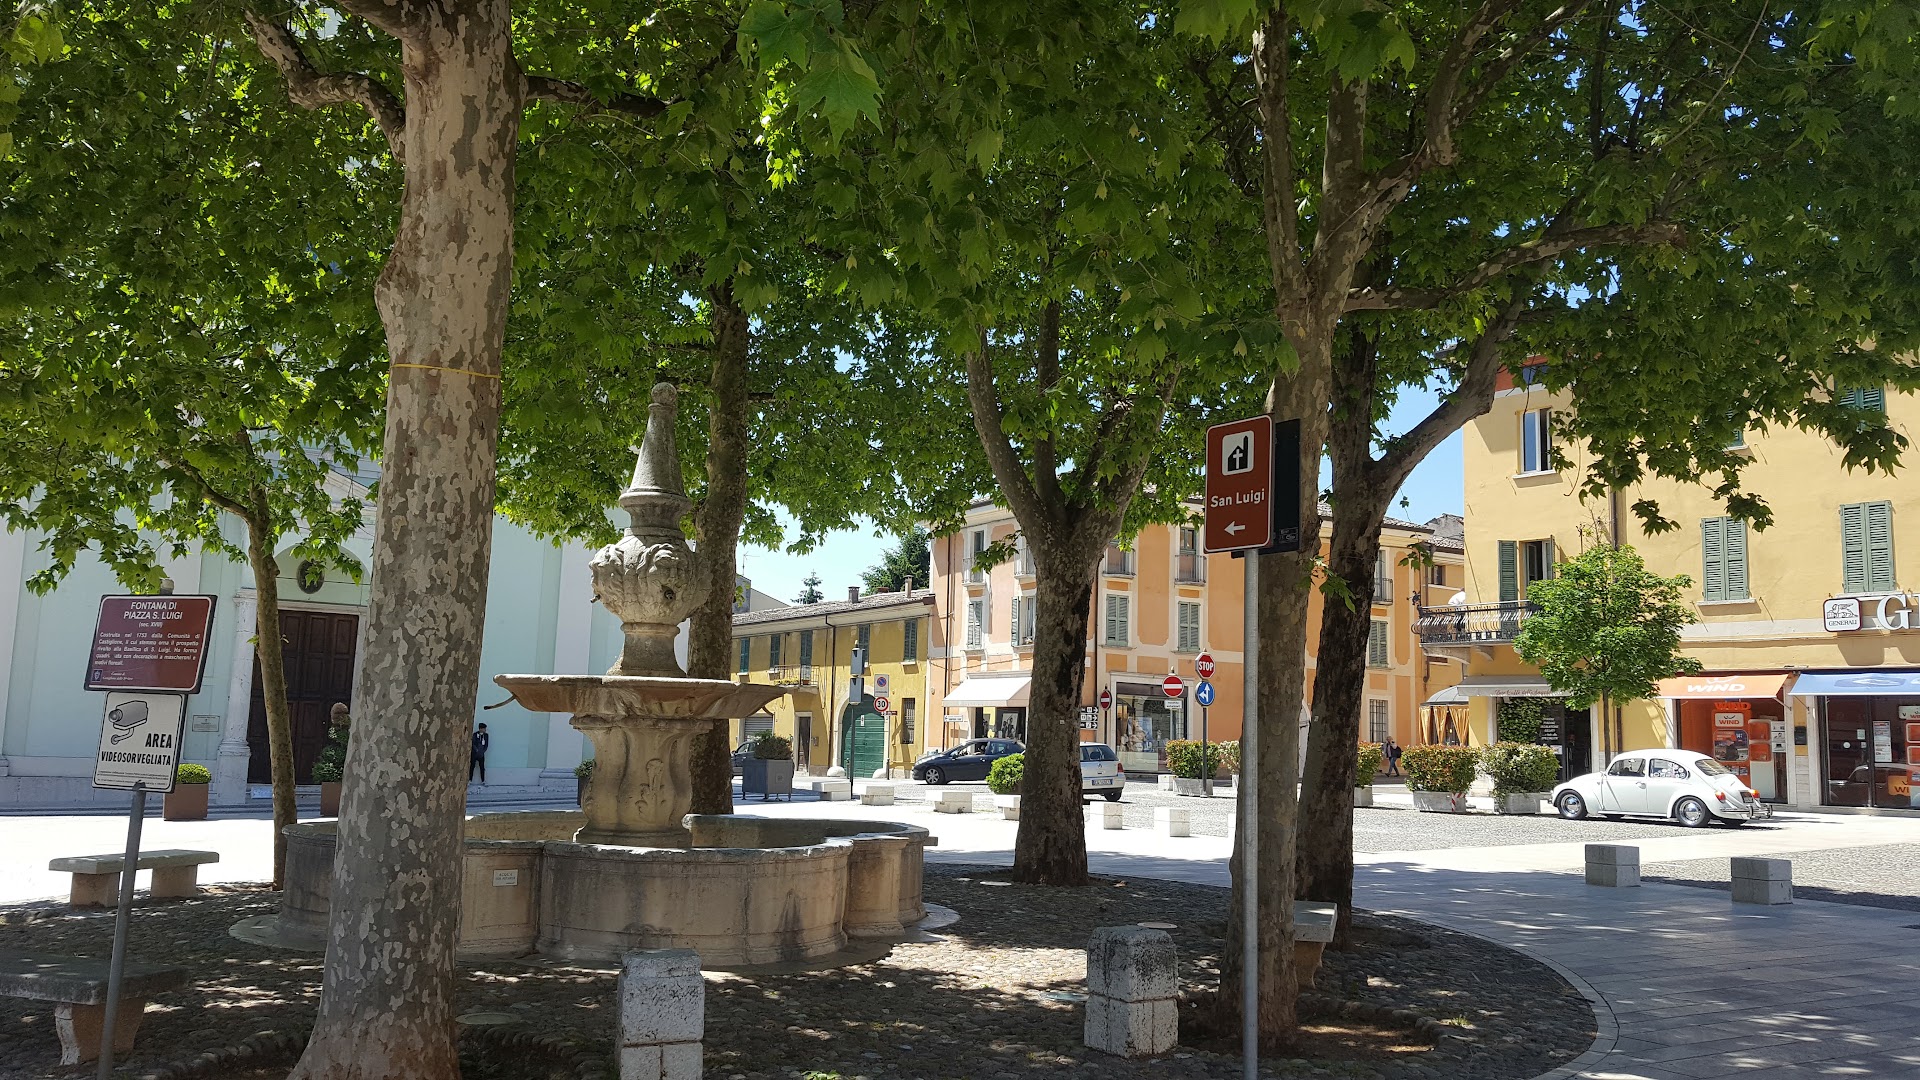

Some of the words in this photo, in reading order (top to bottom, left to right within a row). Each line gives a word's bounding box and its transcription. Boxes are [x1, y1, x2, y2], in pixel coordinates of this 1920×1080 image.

[1210, 495, 1233, 508] San
[1236, 488, 1265, 505] Luigi
[130, 601, 167, 610] FONTANA
[168, 601, 178, 610] DI
[123, 611, 151, 620] PIAZZA
[152, 611, 160, 620] S.
[161, 611, 183, 620] LUIGI
[1198, 661, 1214, 672] STOP
[1687, 683, 1746, 693] WIND
[877, 700, 886, 708] 30
[1714, 701, 1752, 710] WIND
[144, 732, 172, 749] AREA
[101, 750, 171, 766] VIDEOSORVEGLIATA
